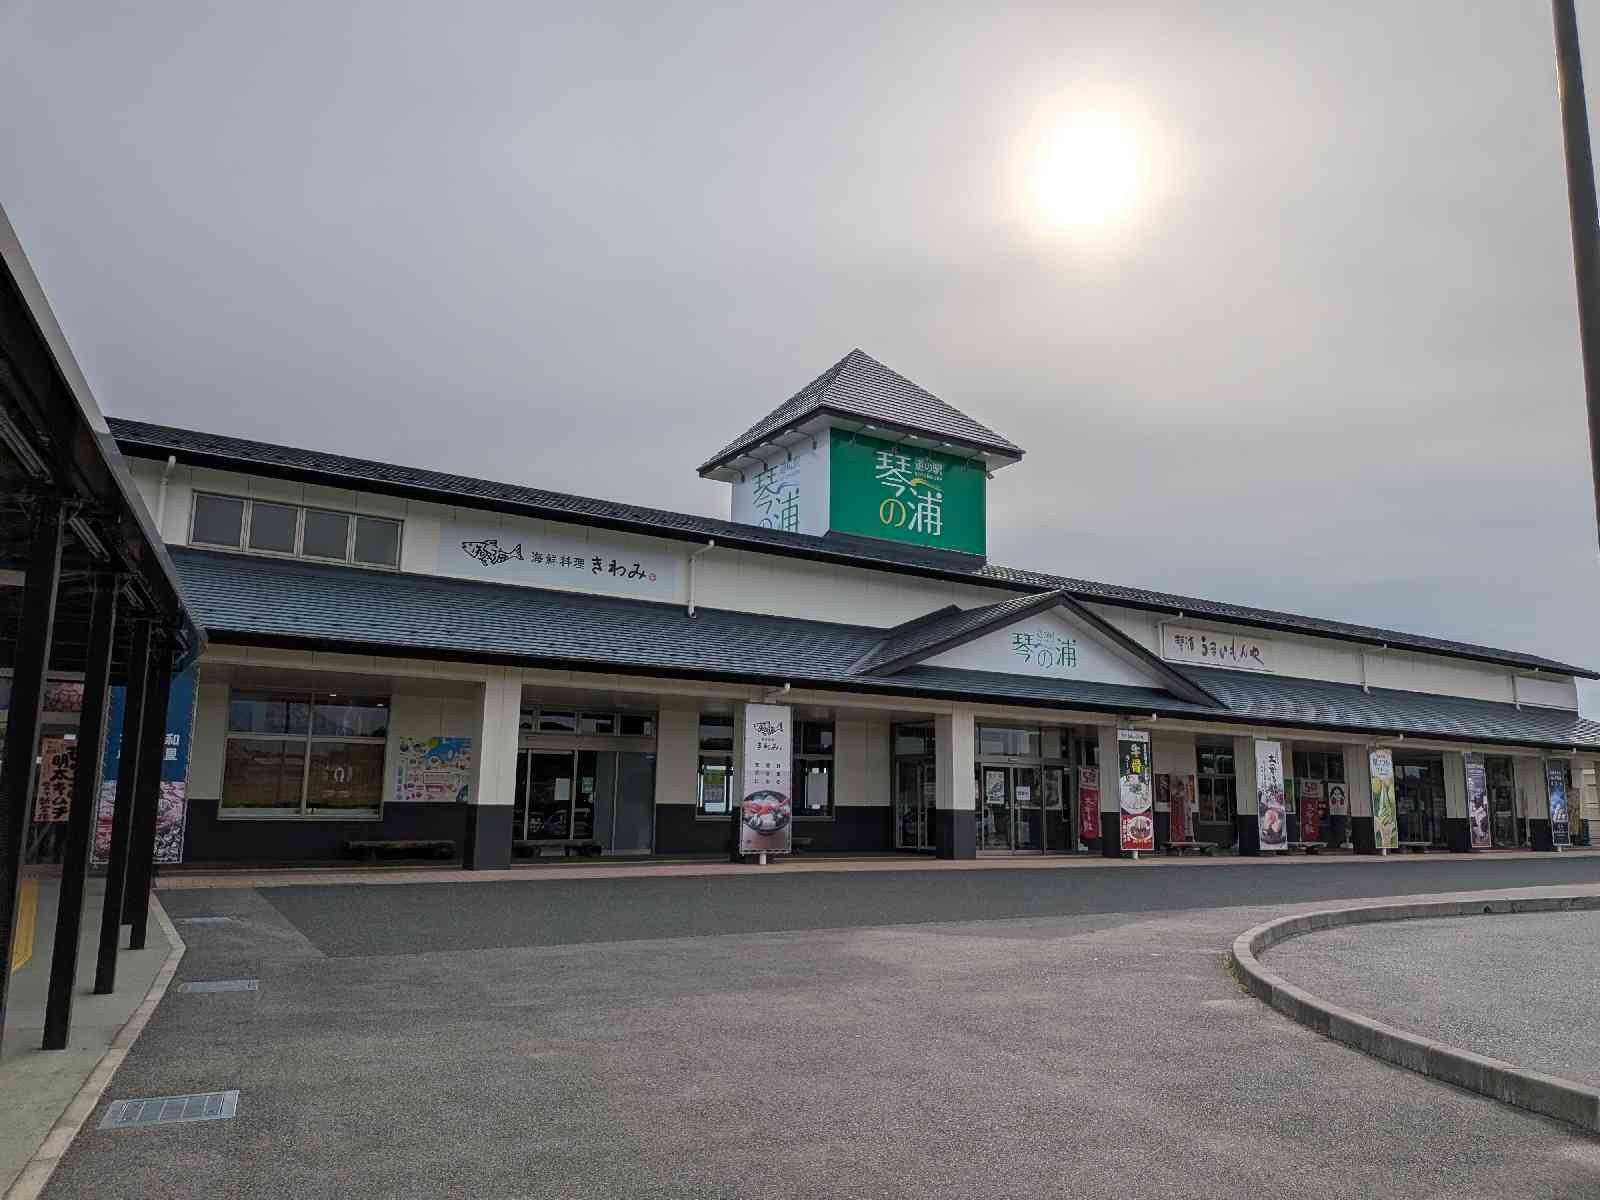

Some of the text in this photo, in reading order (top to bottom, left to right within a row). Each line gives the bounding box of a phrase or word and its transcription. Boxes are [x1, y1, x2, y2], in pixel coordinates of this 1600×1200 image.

[530, 551, 585, 570] 海鮮料理
[591, 555, 647, 580] きわみ
[1011, 632, 1078, 668] 琴の浦
